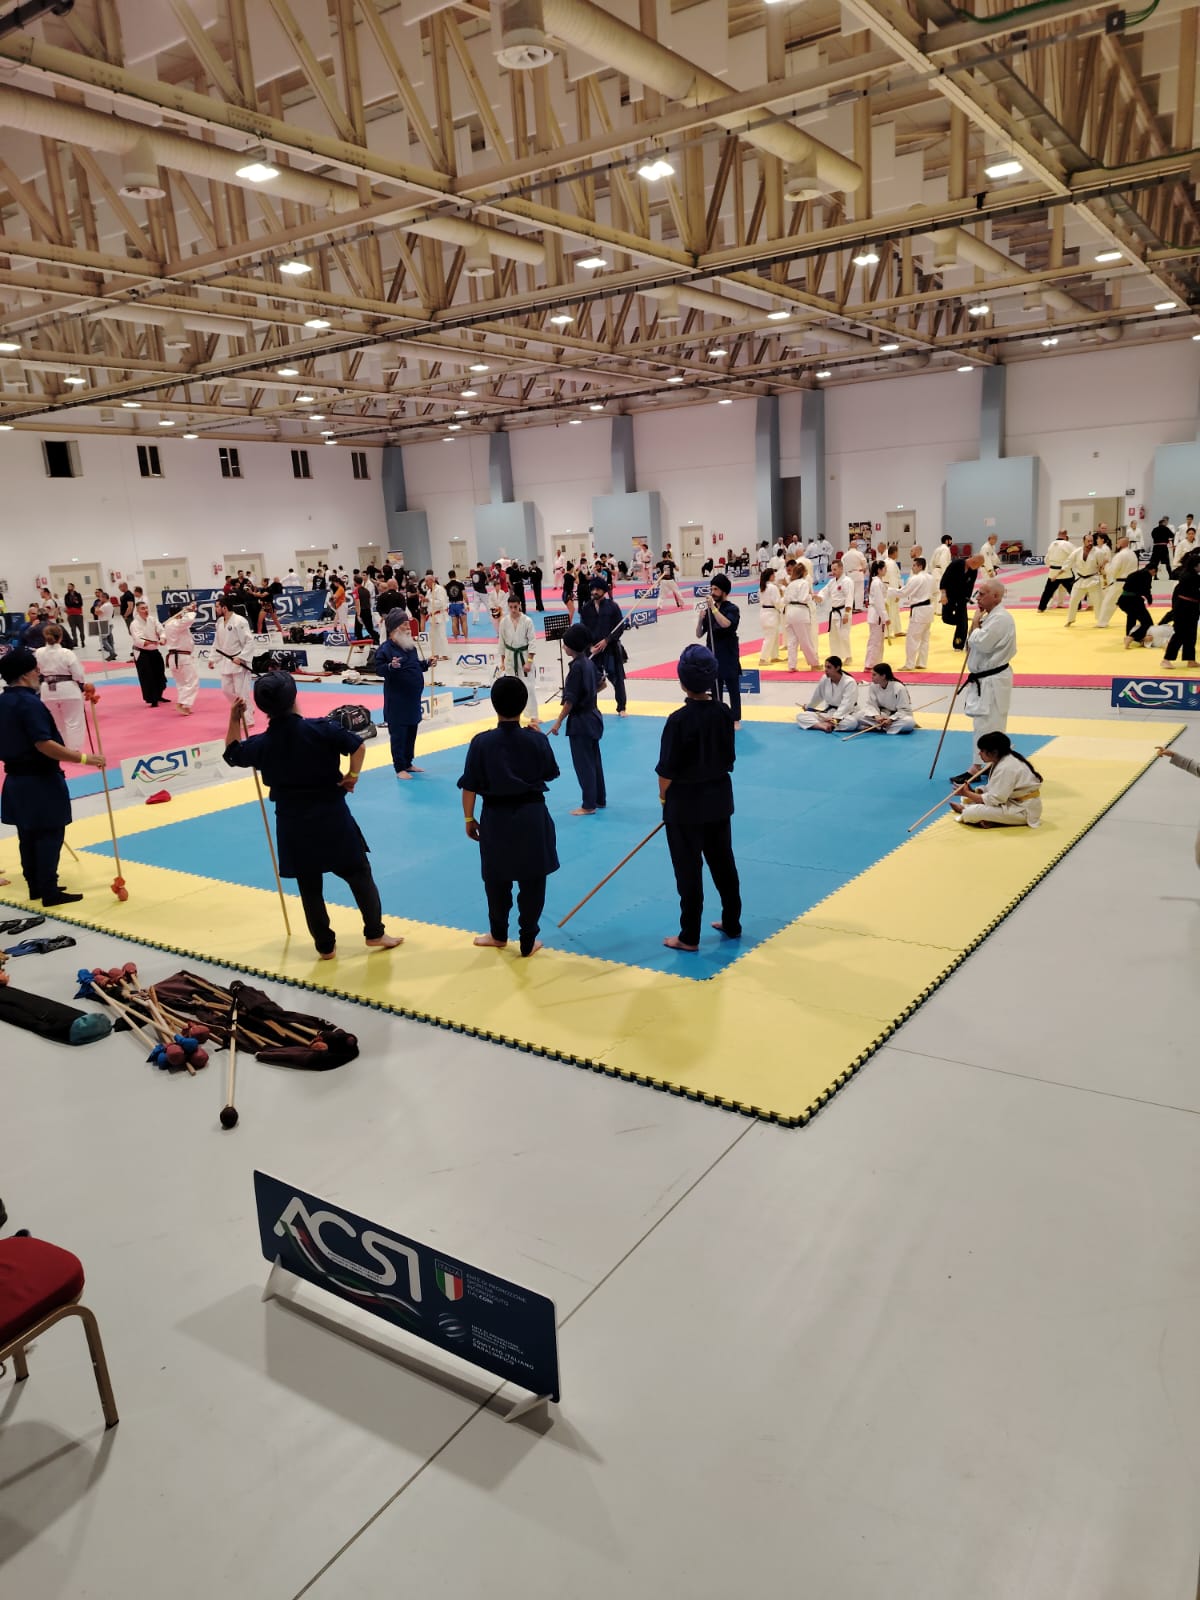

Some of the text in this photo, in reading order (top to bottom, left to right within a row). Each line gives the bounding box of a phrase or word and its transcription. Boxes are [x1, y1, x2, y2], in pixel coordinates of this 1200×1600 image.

[165, 591, 190, 604] ACSI
[632, 611, 648, 625] ACSI
[326, 633, 346, 643] ACSI
[456, 654, 487, 666] ACSI
[1118, 681, 1183, 699] ACSI
[131, 750, 188, 780] ACSI
[273, 1196, 422, 1303] ACSI
